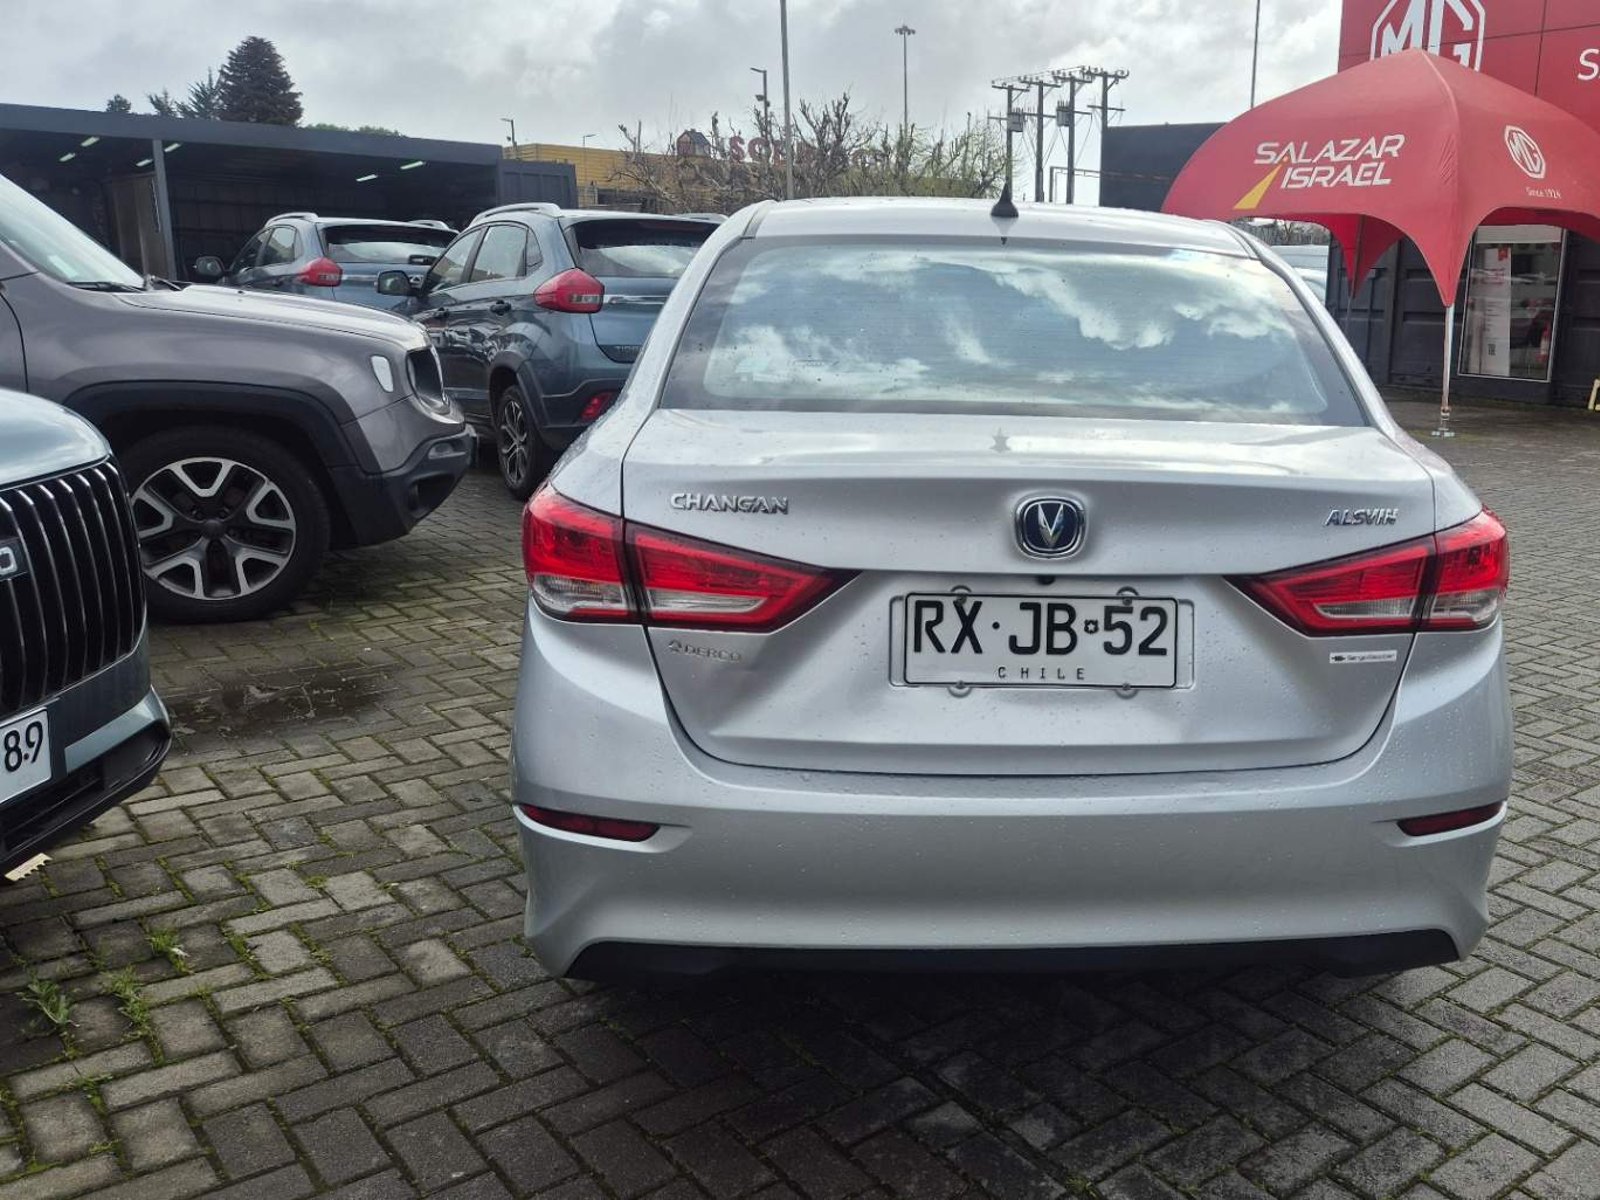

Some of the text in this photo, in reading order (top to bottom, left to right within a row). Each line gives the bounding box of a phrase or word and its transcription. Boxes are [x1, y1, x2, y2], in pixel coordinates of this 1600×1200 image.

[1380, 0, 1474, 68] MG
[1253, 134, 1405, 165] SALAZAR
[1508, 130, 1542, 174] MG
[1280, 161, 1392, 189] ISRAEL
[670, 493, 788, 515] CHANGAN
[998, 666, 1085, 680] CHILE
